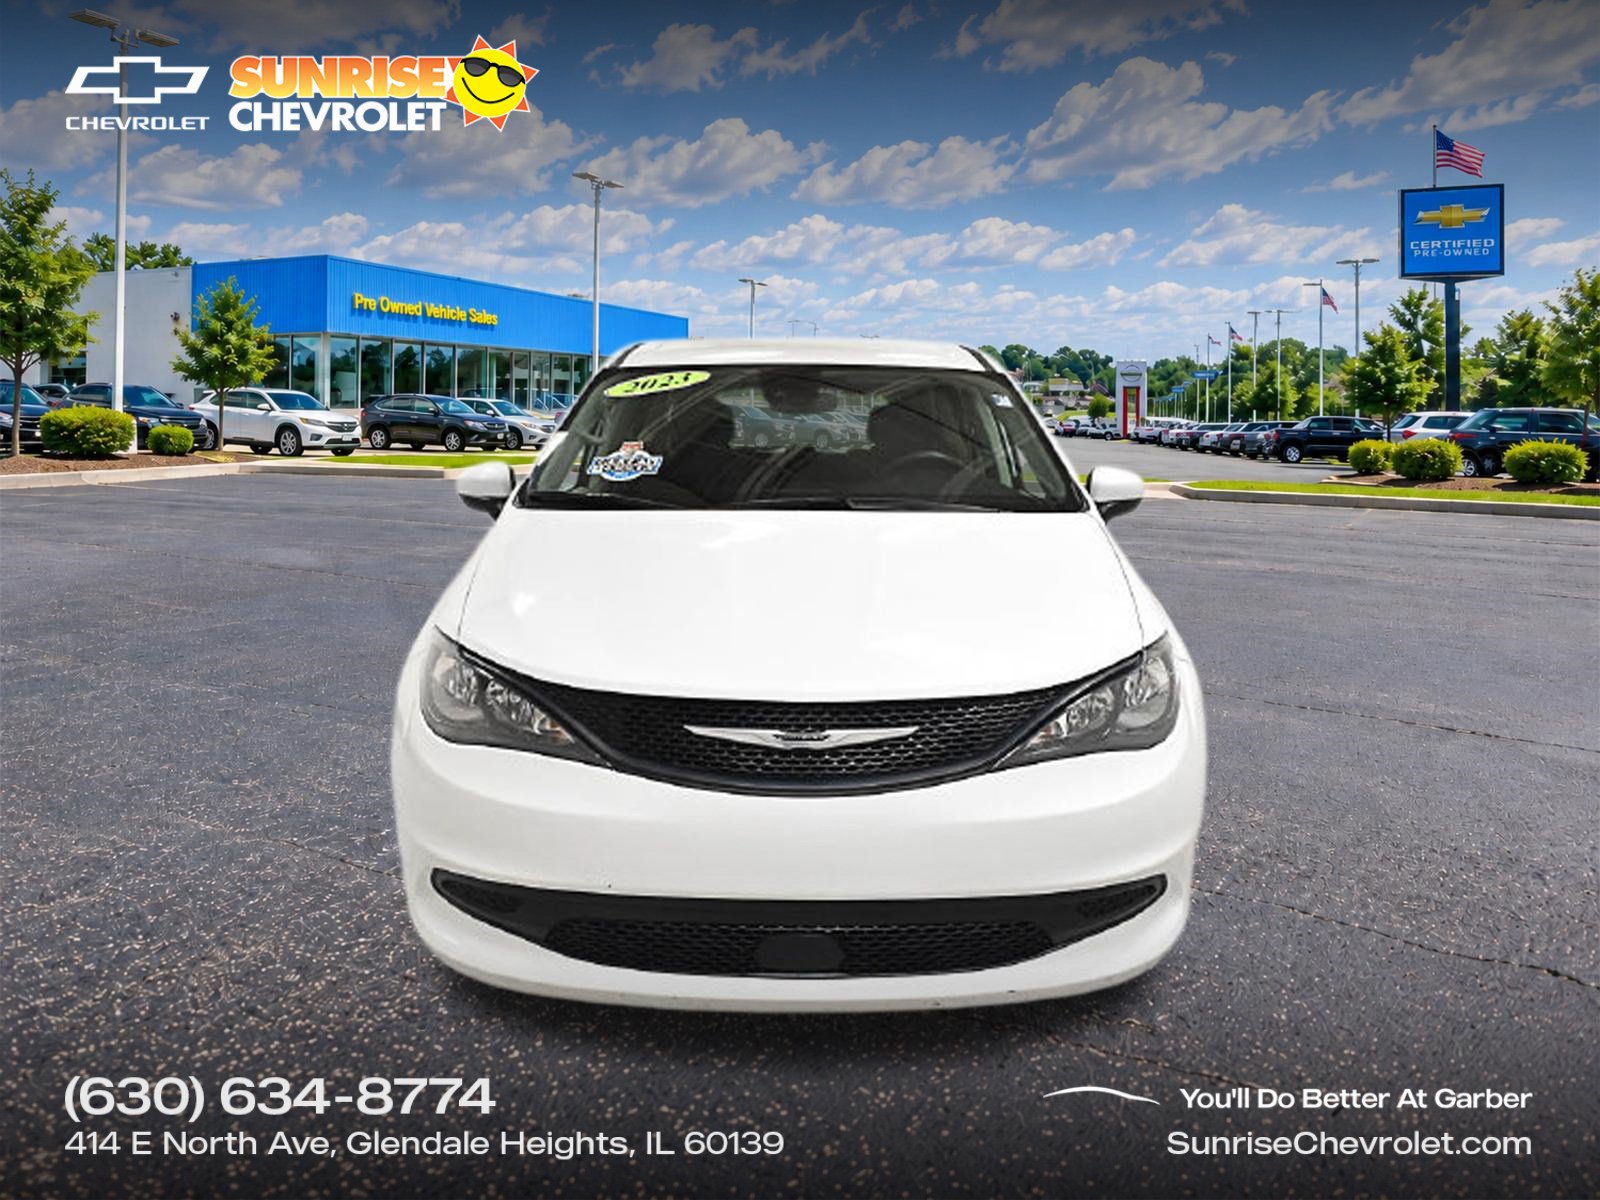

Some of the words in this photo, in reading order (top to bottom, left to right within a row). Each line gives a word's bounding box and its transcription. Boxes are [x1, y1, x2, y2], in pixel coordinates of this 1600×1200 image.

[1410, 239, 1495, 250] CERTIFIED
[1414, 248, 1489, 257] PRE-OWNED
[354, 293, 377, 311] Pre
[379, 296, 422, 316] Owned
[425, 302, 467, 321] Vehicle
[469, 308, 498, 326] Sales
